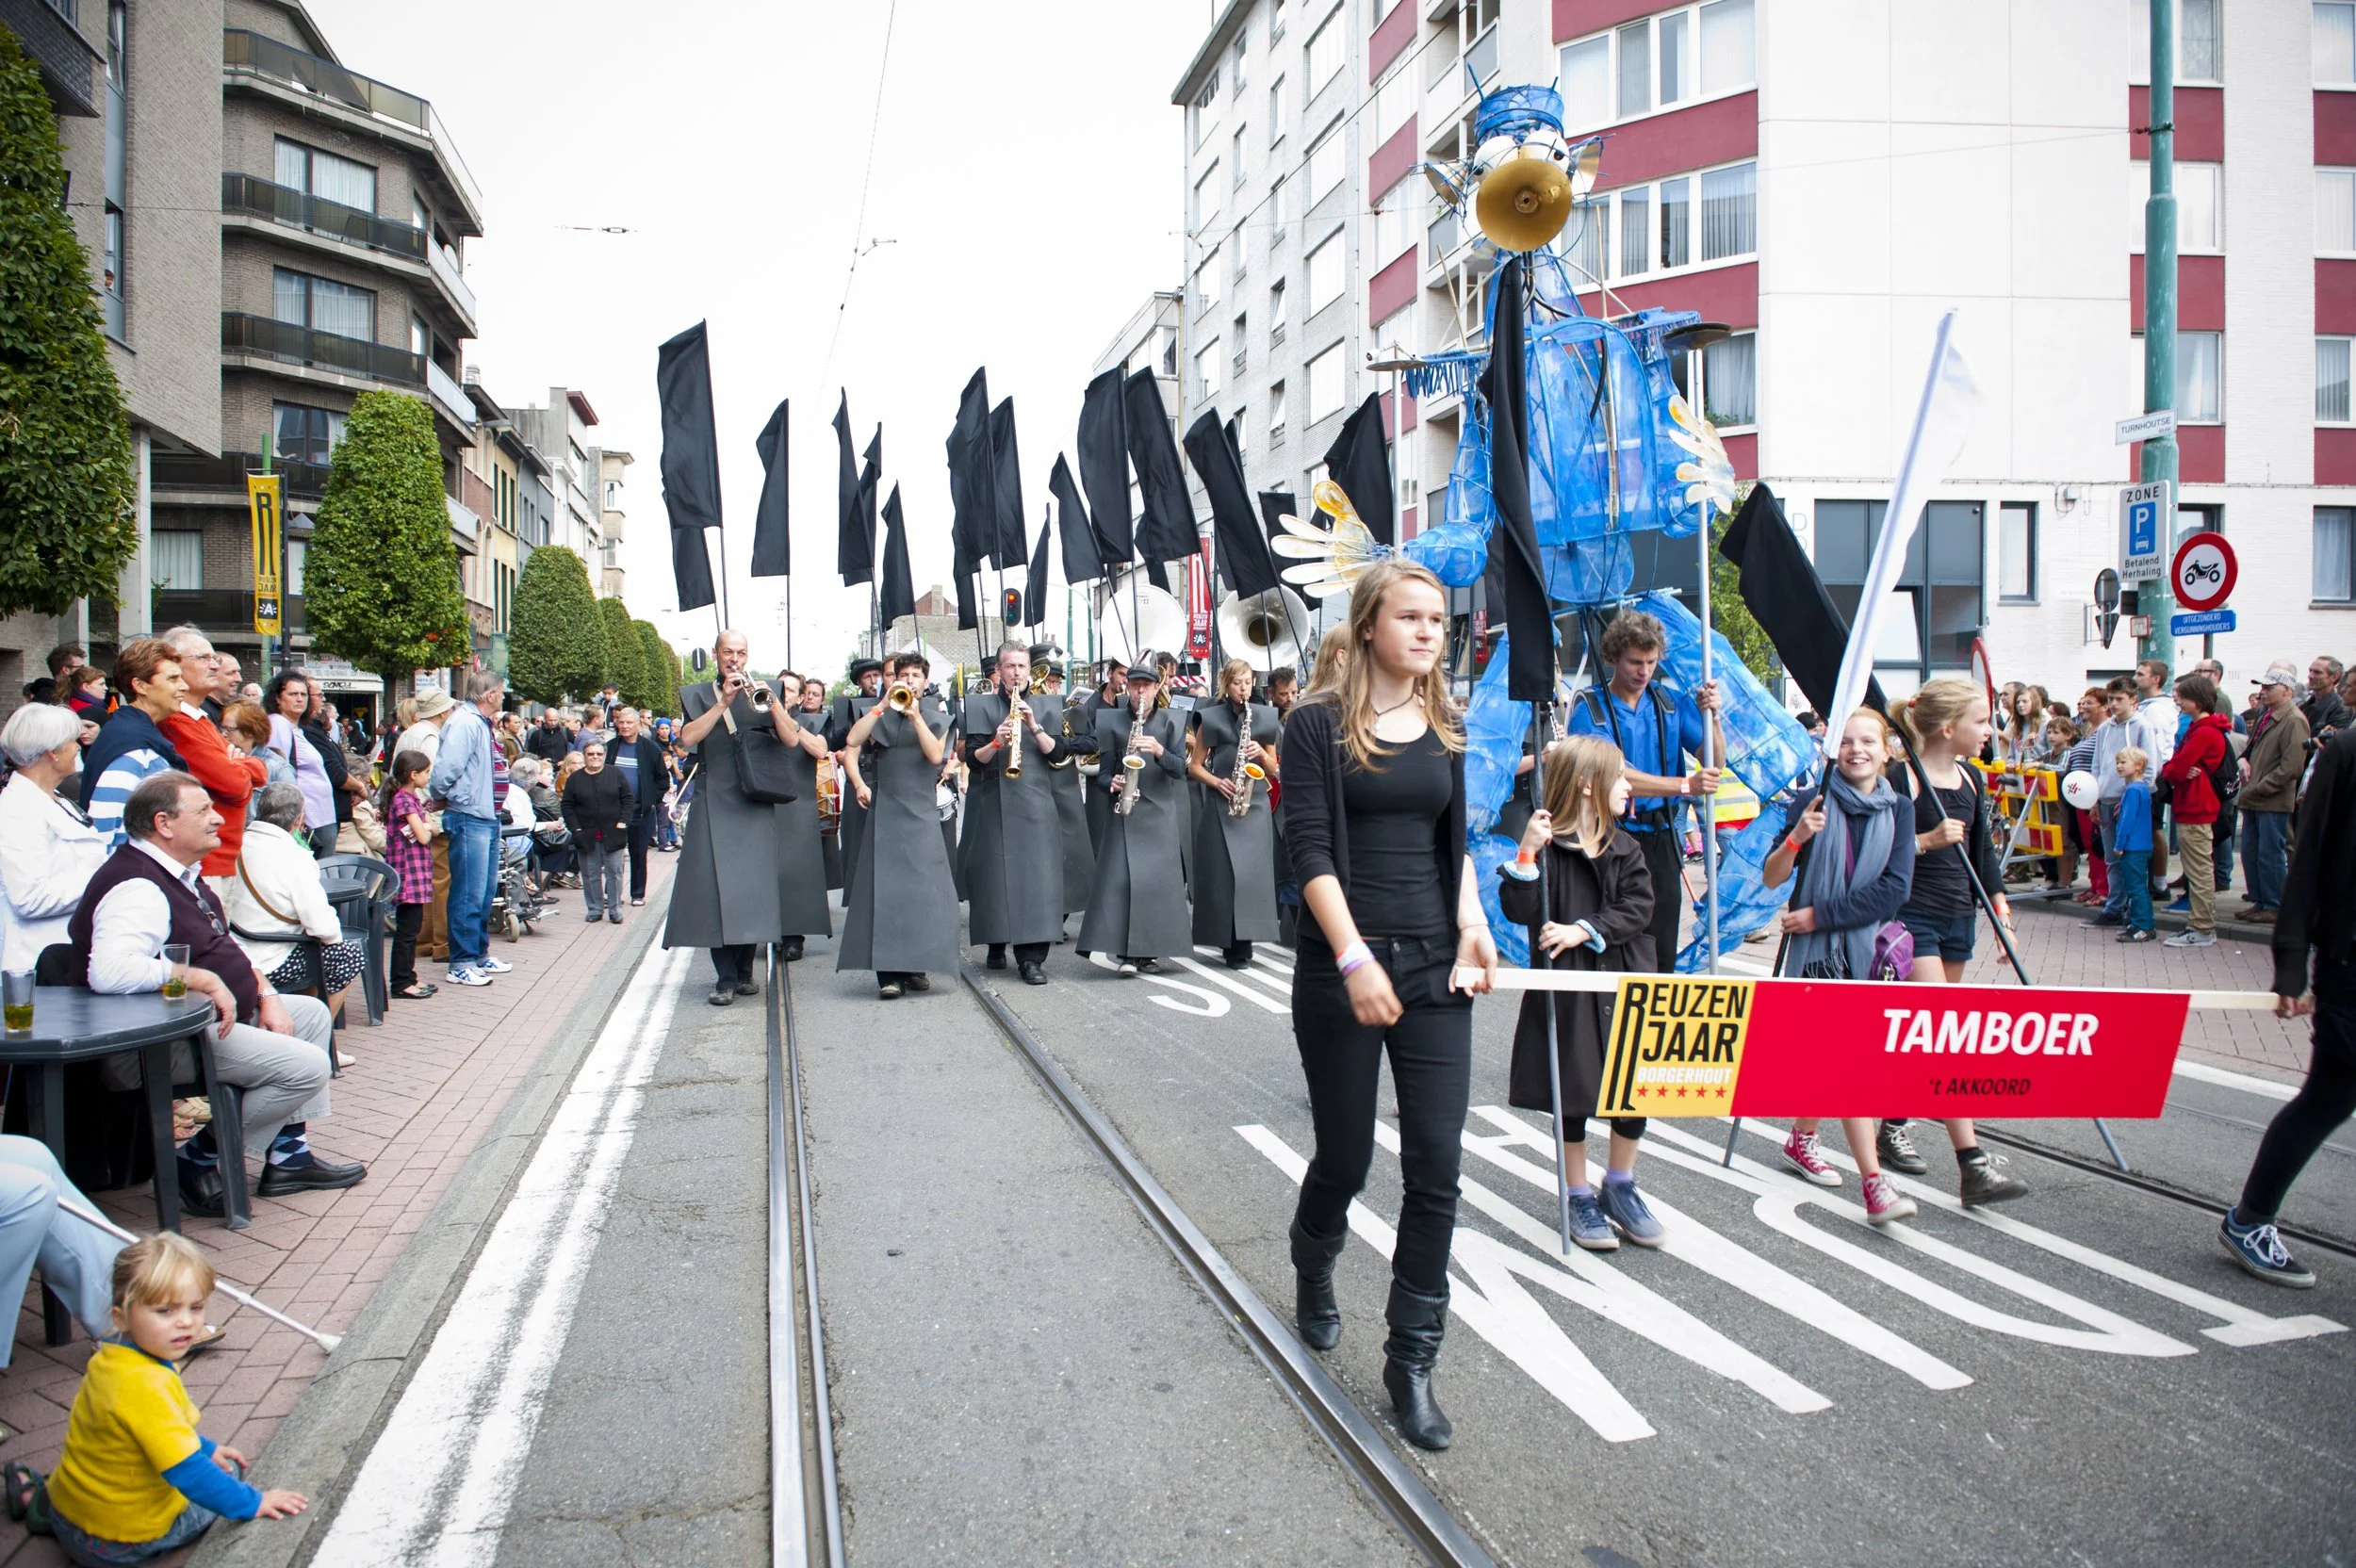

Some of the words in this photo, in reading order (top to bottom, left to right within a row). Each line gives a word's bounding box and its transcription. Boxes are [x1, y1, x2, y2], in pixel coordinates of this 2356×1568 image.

[2120, 416, 2171, 434] TURNHOUTSE
[2126, 485, 2160, 503] ZONE
[2135, 507, 2150, 534] P
[2124, 555, 2160, 568] Betalend
[2122, 566, 2161, 579] Herhaling
[2183, 612, 2221, 624] UITGEZONDERD
[1883, 1008, 2100, 1056] TAMBOER
[1642, 1021, 1740, 1063] JAAR
[1636, 1066, 1733, 1085] BORGERHOUT
[1945, 1078, 2032, 1096] AKKOORD
